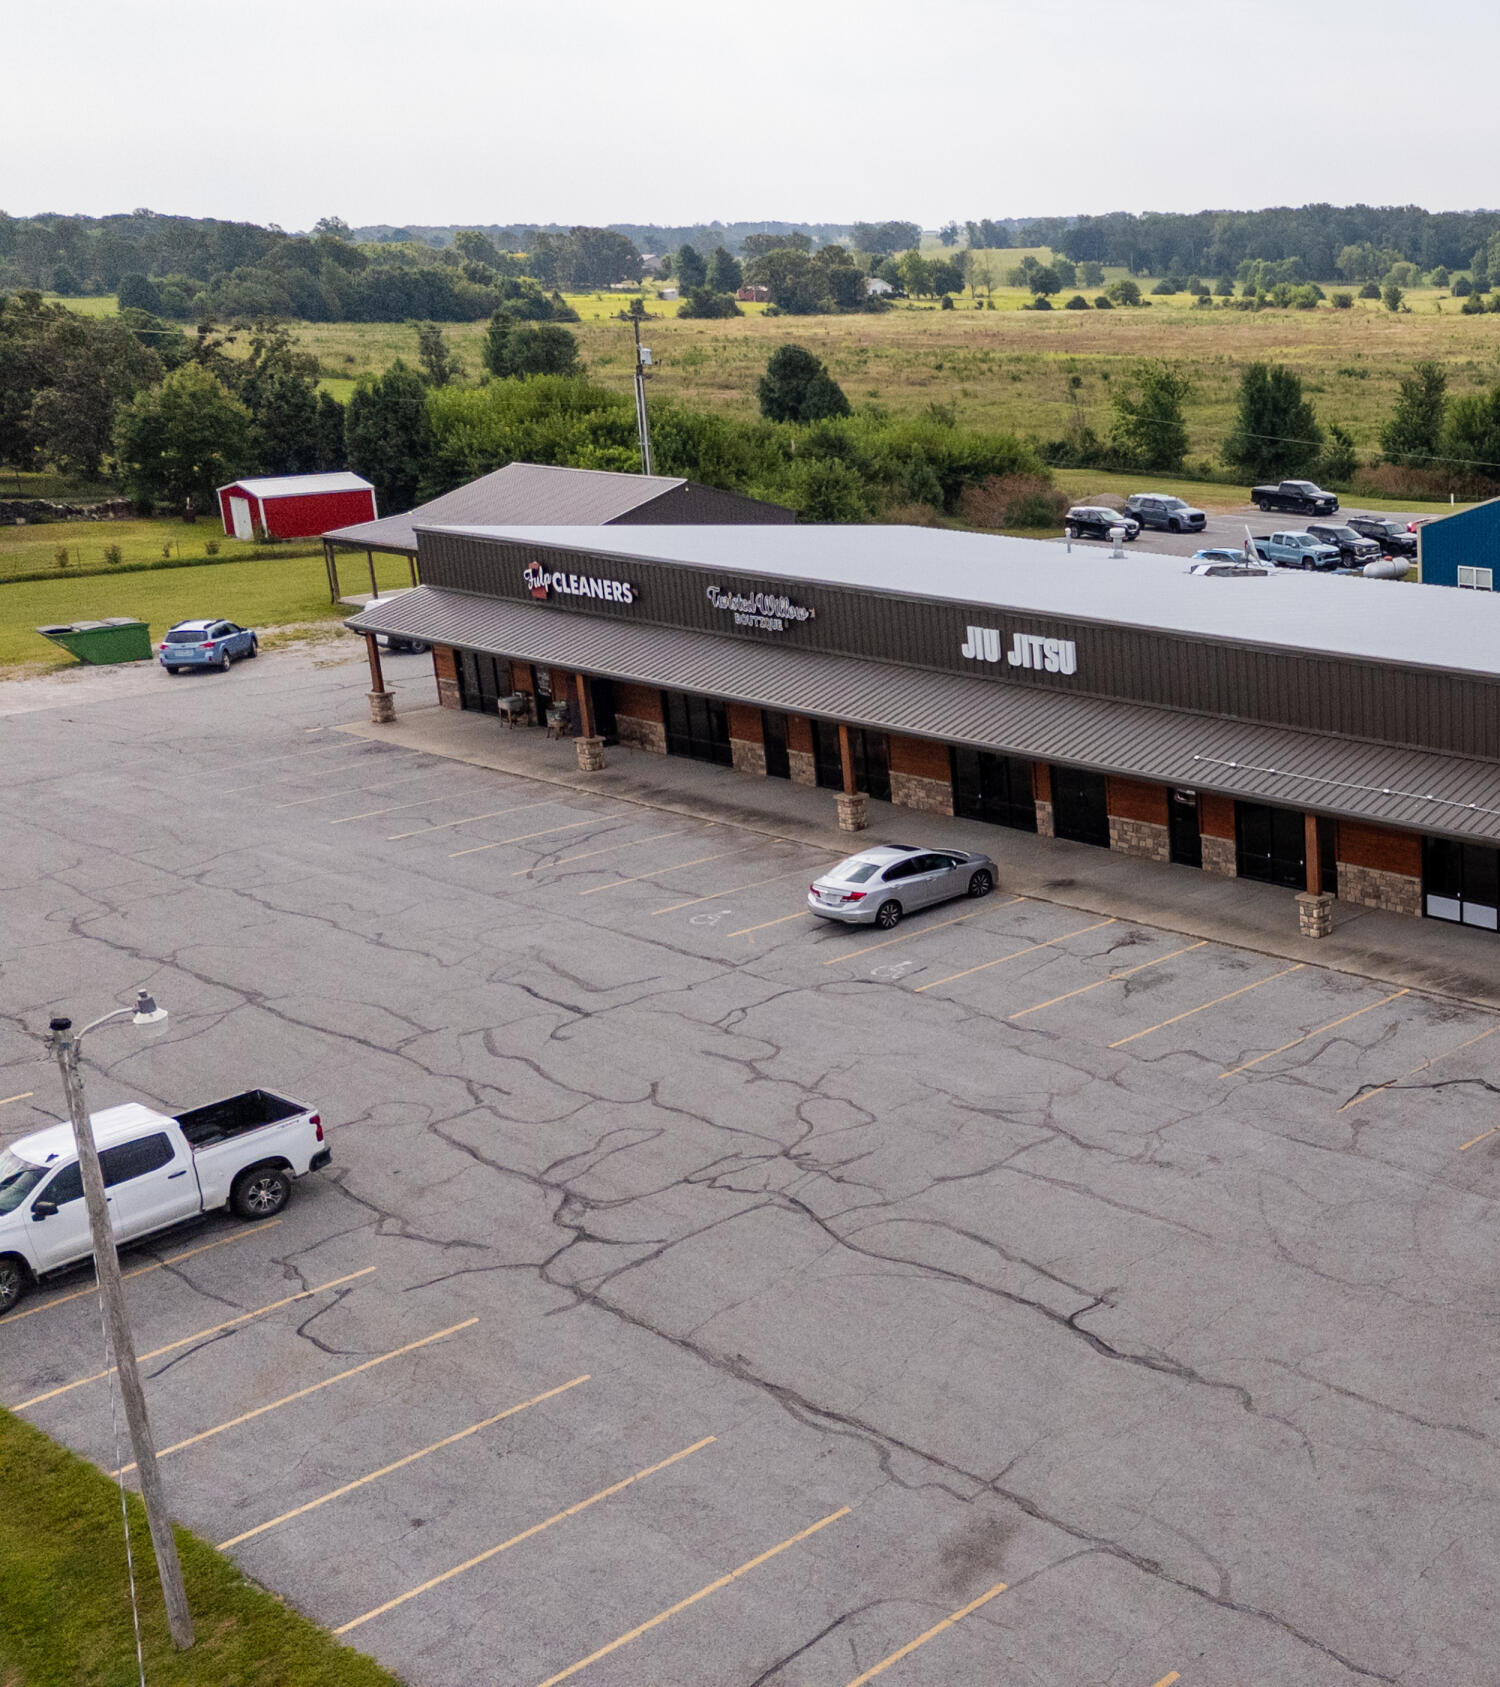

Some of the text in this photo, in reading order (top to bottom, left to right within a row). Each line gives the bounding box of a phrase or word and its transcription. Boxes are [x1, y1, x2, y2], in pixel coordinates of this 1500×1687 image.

[523, 565, 633, 604] Fulp CLEANERS
[734, 612, 784, 632] BOUTIQUE
[755, 592, 810, 621] Willow
[961, 625, 1077, 675] JIU JITSU
